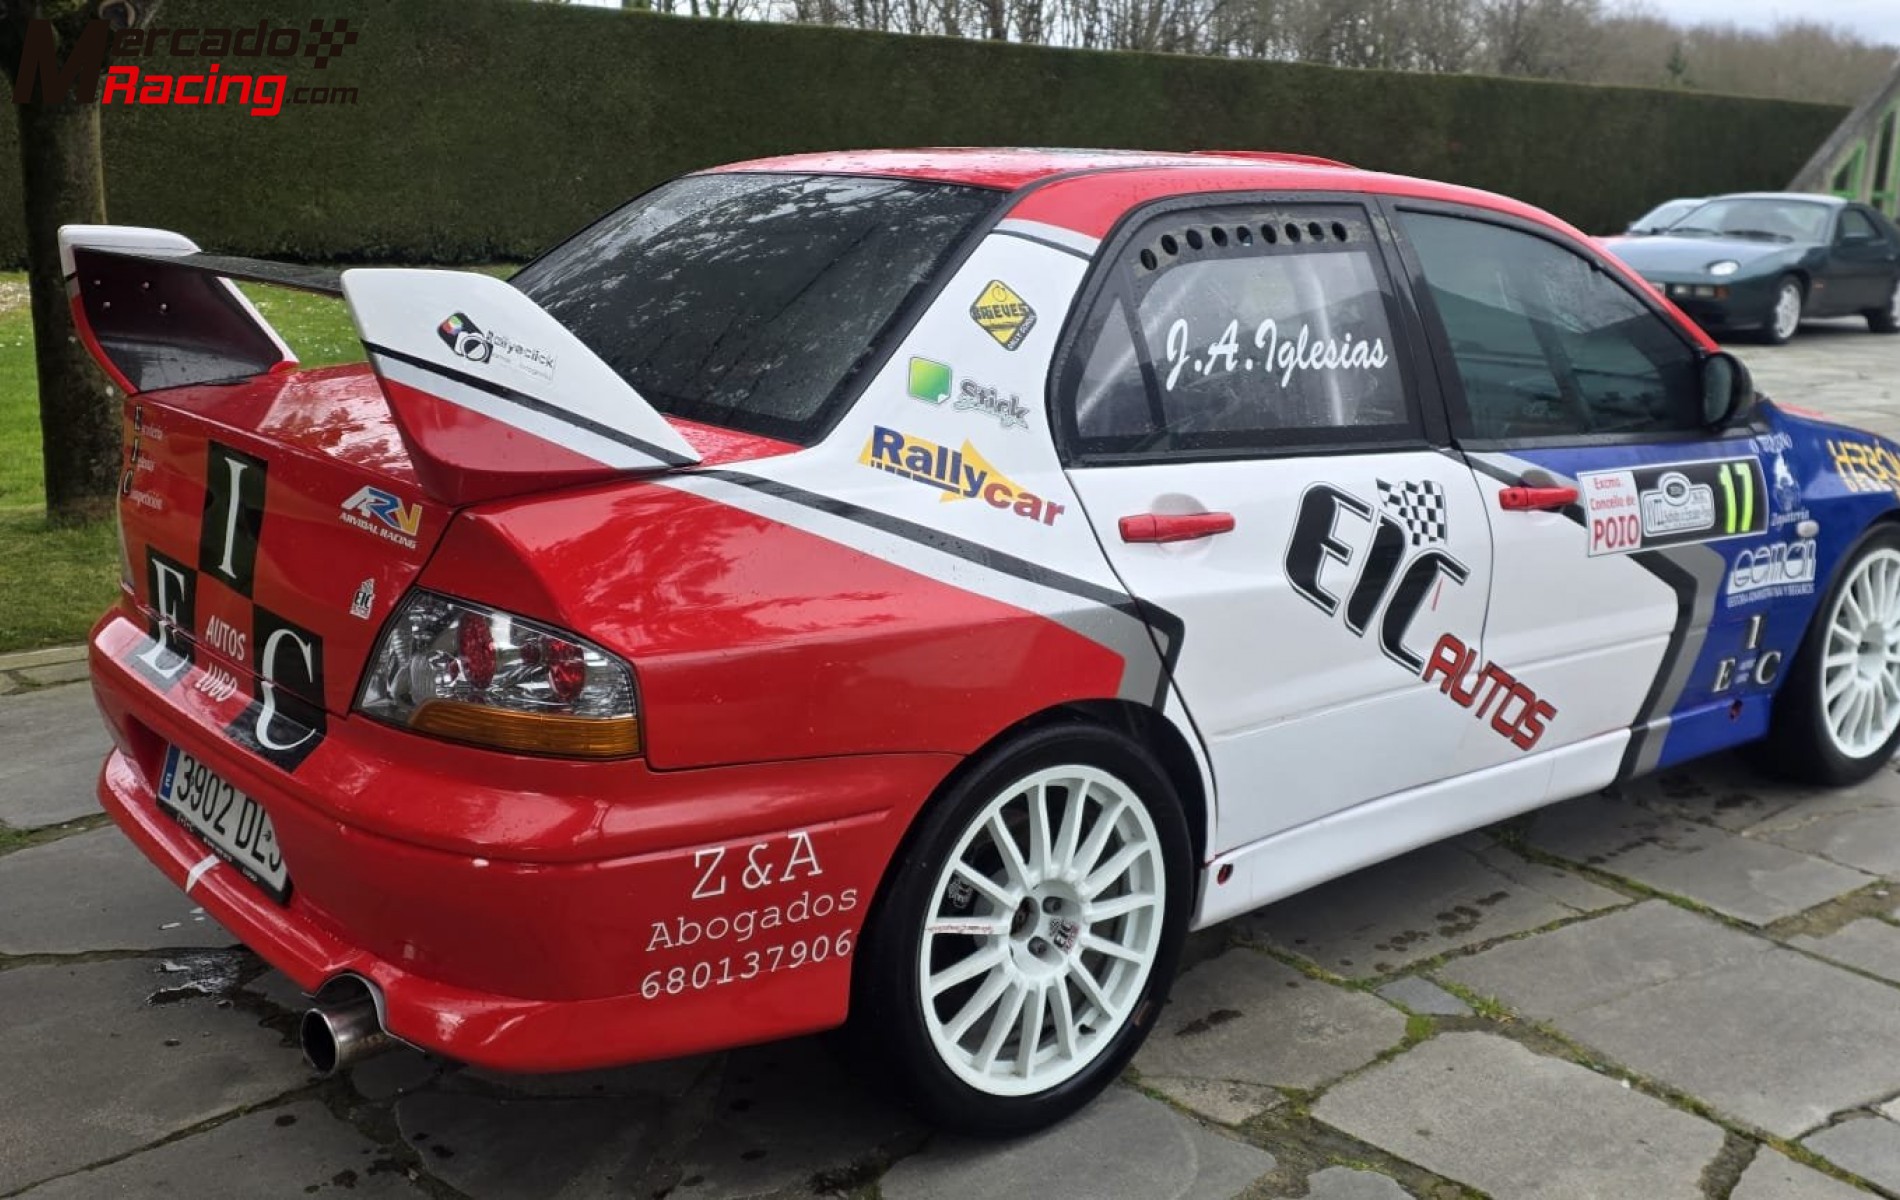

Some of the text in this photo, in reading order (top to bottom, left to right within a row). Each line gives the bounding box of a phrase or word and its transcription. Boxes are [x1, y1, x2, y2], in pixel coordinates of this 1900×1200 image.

[871, 424, 1065, 527] Rallycar
[1719, 462, 1754, 534] 17
[380, 528, 417, 550] RACING
[1593, 514, 1640, 551] POIO
[1283, 480, 1471, 677] EIC
[205, 614, 246, 661] AUTOS
[1422, 632, 1557, 752] AUTOS
[177, 755, 235, 836] 3902
[692, 830, 824, 900] Z & A
[645, 888, 859, 952] Abogados
[640, 929, 853, 1000] 680137906
